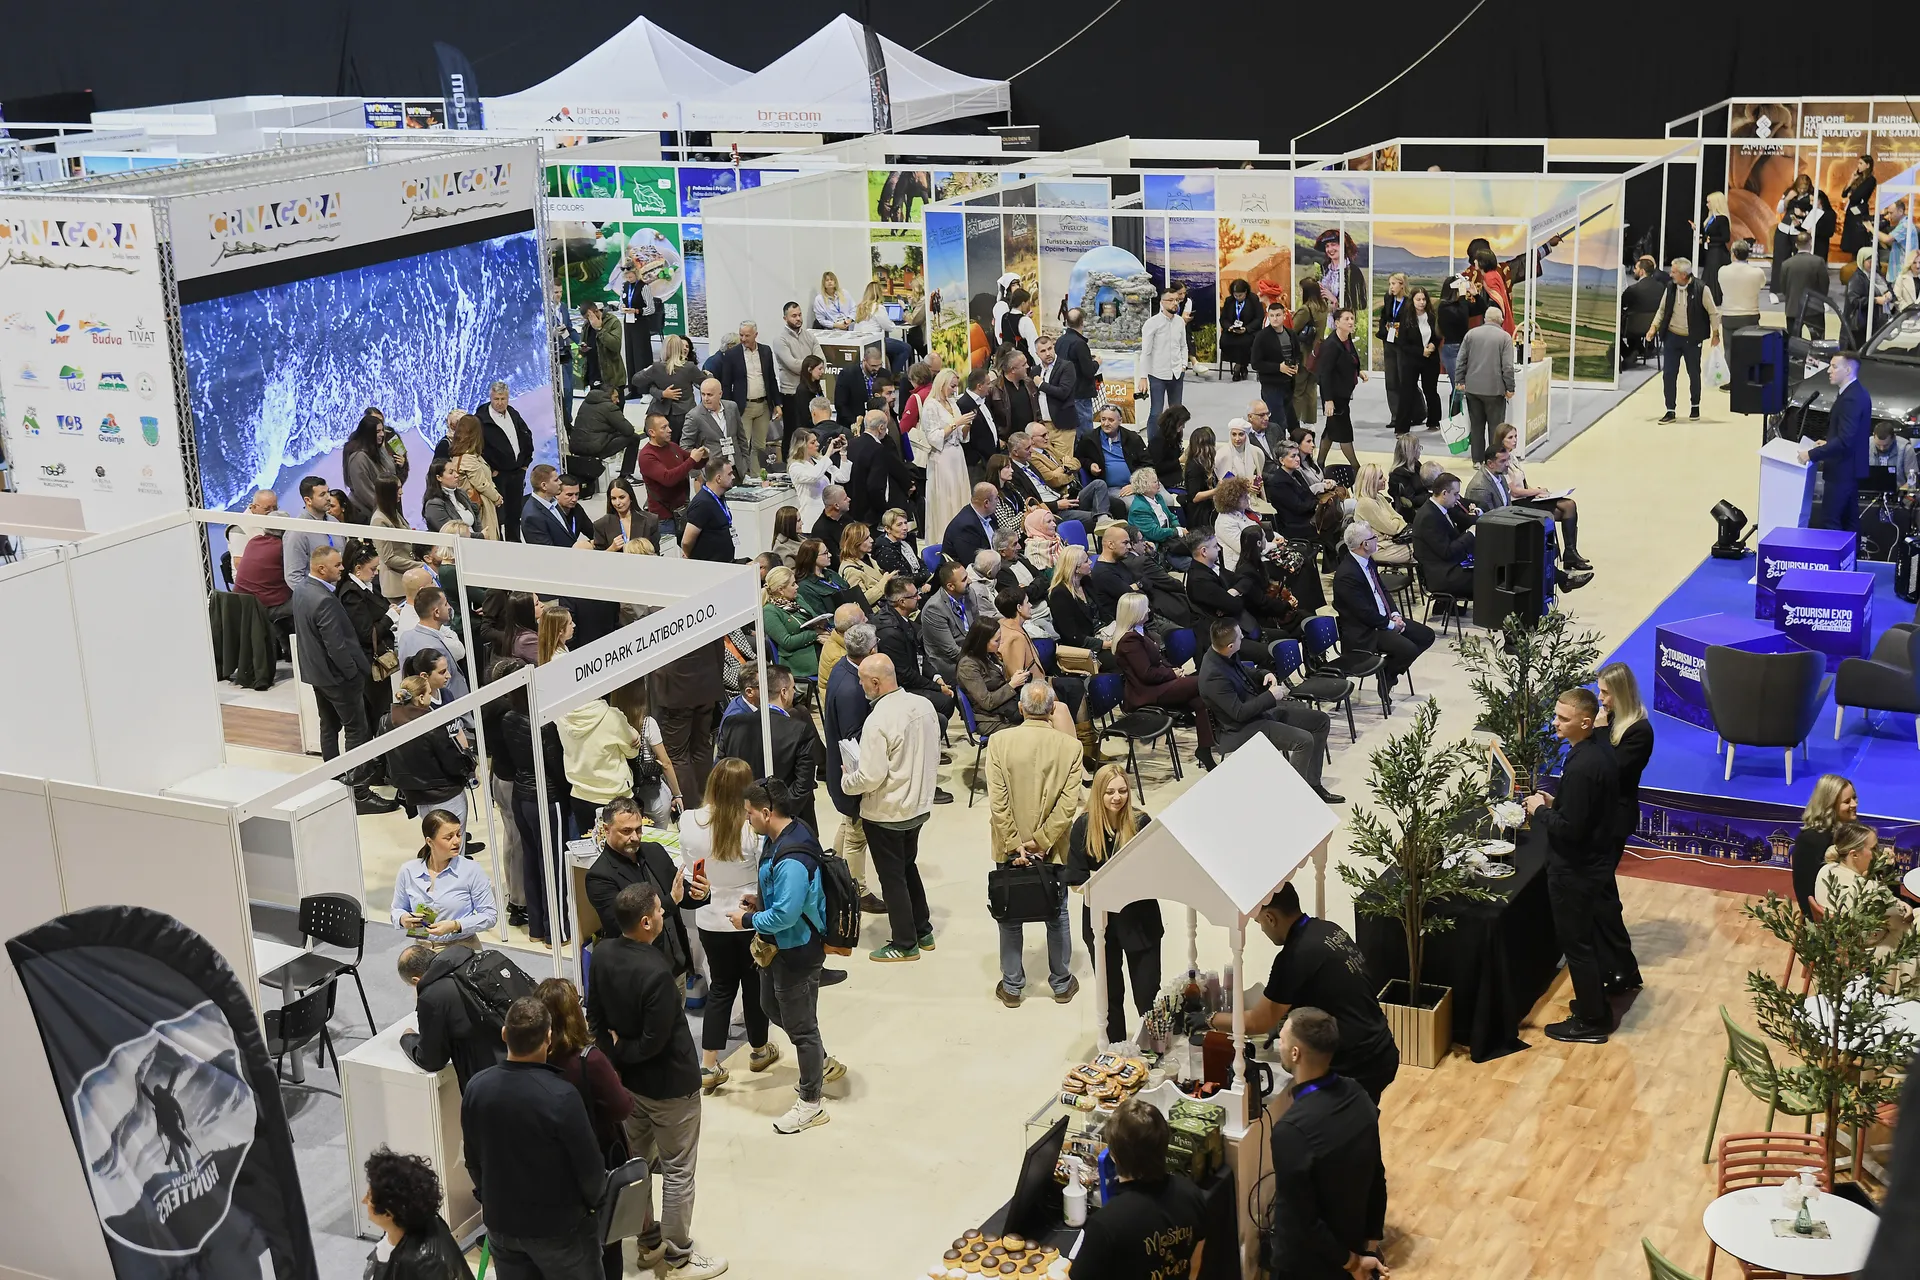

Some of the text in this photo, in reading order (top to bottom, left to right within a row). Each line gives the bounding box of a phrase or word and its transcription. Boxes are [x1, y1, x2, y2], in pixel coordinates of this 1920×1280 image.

[576, 107, 620, 115] bracom
[758, 109, 821, 121] bracom
[577, 116, 620, 126] OUTDOOR
[1803, 115, 1845, 124] EXPLORE
[1877, 115, 1912, 124] ENRICH
[1803, 128, 1813, 137] IN
[1876, 129, 1887, 138] IN
[557, 204, 585, 213] COLORS
[1074, 239, 1101, 248] zajednica
[1044, 246, 1065, 254] Općine
[92, 332, 123, 345] Budva
[128, 330, 156, 343] TIVAT
[65, 378, 86, 391] Tuzi
[98, 434, 125, 445] Gusinje
[1775, 560, 1829, 571] TOURISM EXPO
[1796, 606, 1853, 620] TOURISM EXPO
[575, 604, 717, 682] DINO PARK ZLATIBOR D.O.O.
[1667, 648, 1693, 666] TOURISM
